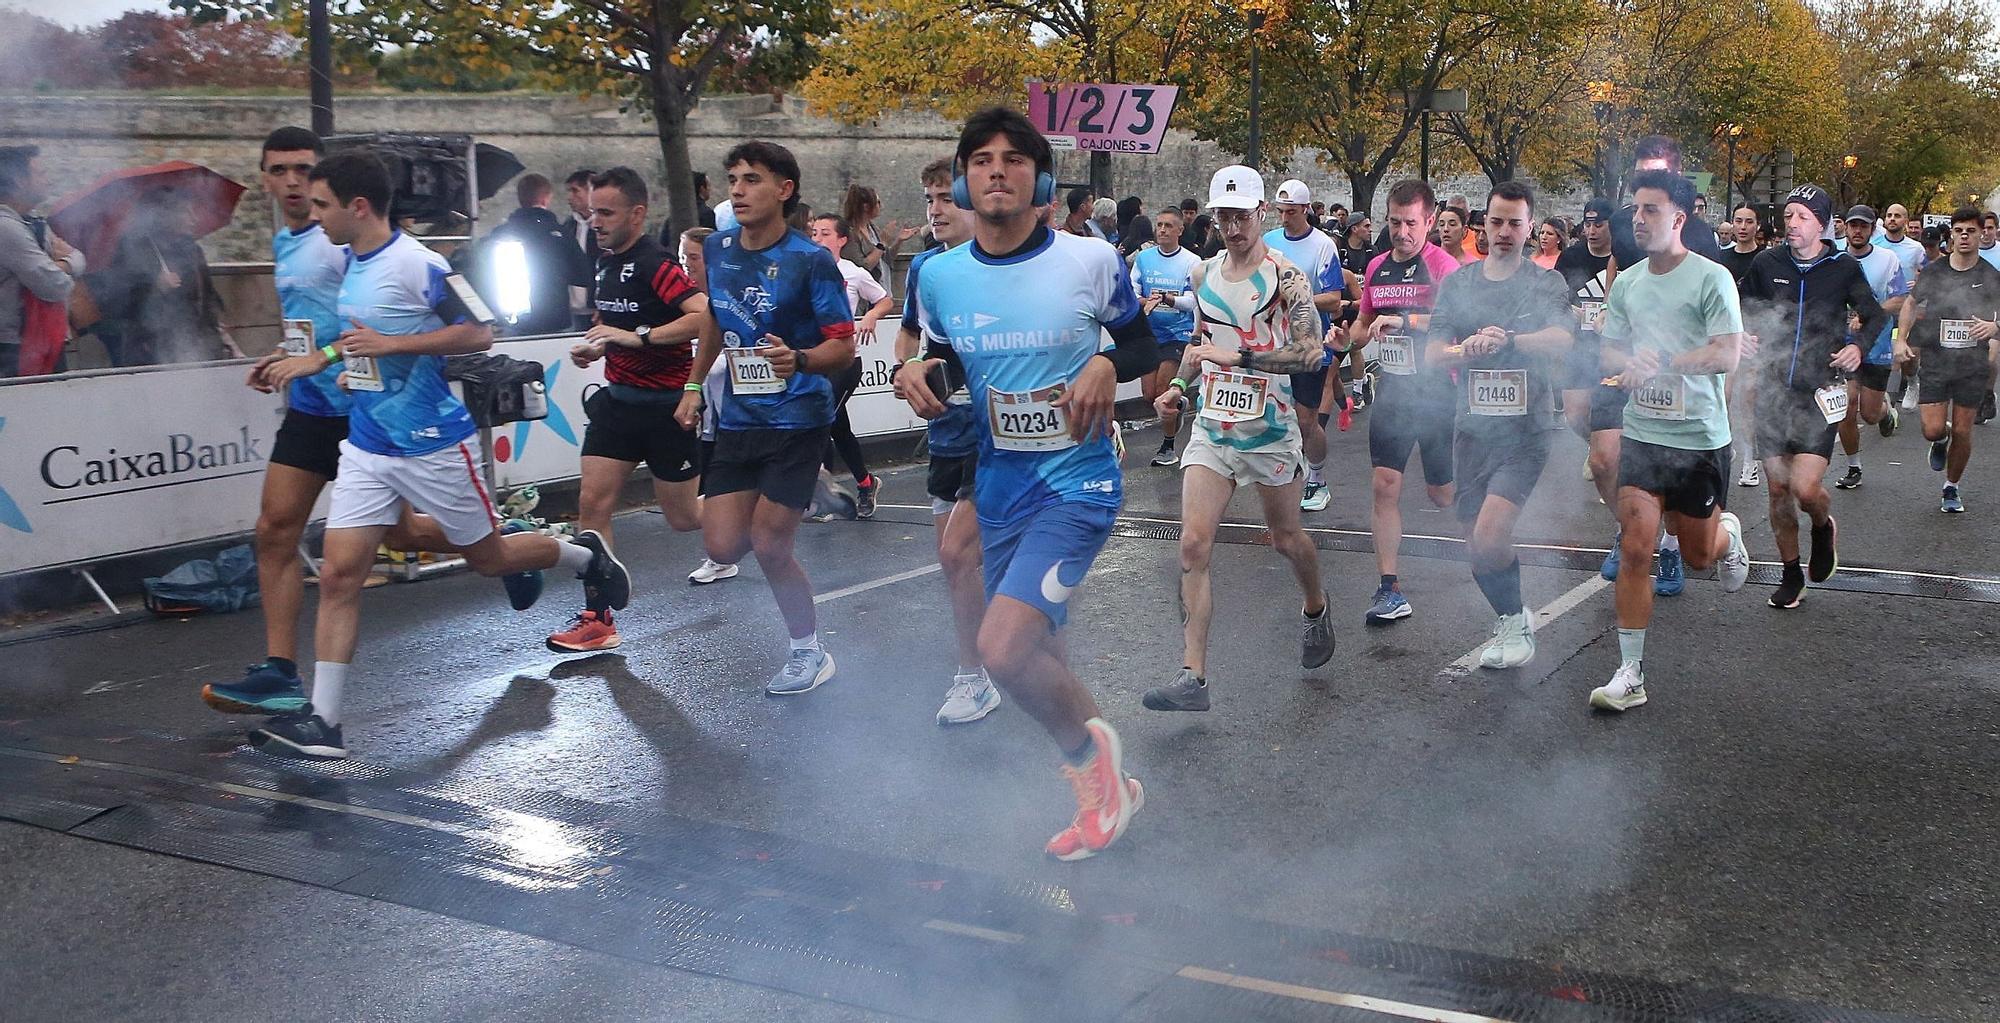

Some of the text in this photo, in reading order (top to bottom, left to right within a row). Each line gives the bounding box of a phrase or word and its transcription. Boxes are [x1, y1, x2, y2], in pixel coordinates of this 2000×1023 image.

[1044, 86, 1155, 135] 1/2/3
[1080, 138, 1136, 151] CAJONES
[1927, 215, 1934, 225] 5
[738, 363, 771, 380] 21021
[1215, 389, 1254, 410] 21051
[1478, 386, 1516, 402] 21448
[1640, 387, 1673, 406] 21449
[1001, 409, 1060, 434] 21234
[40, 425, 264, 490] CaixaBank
